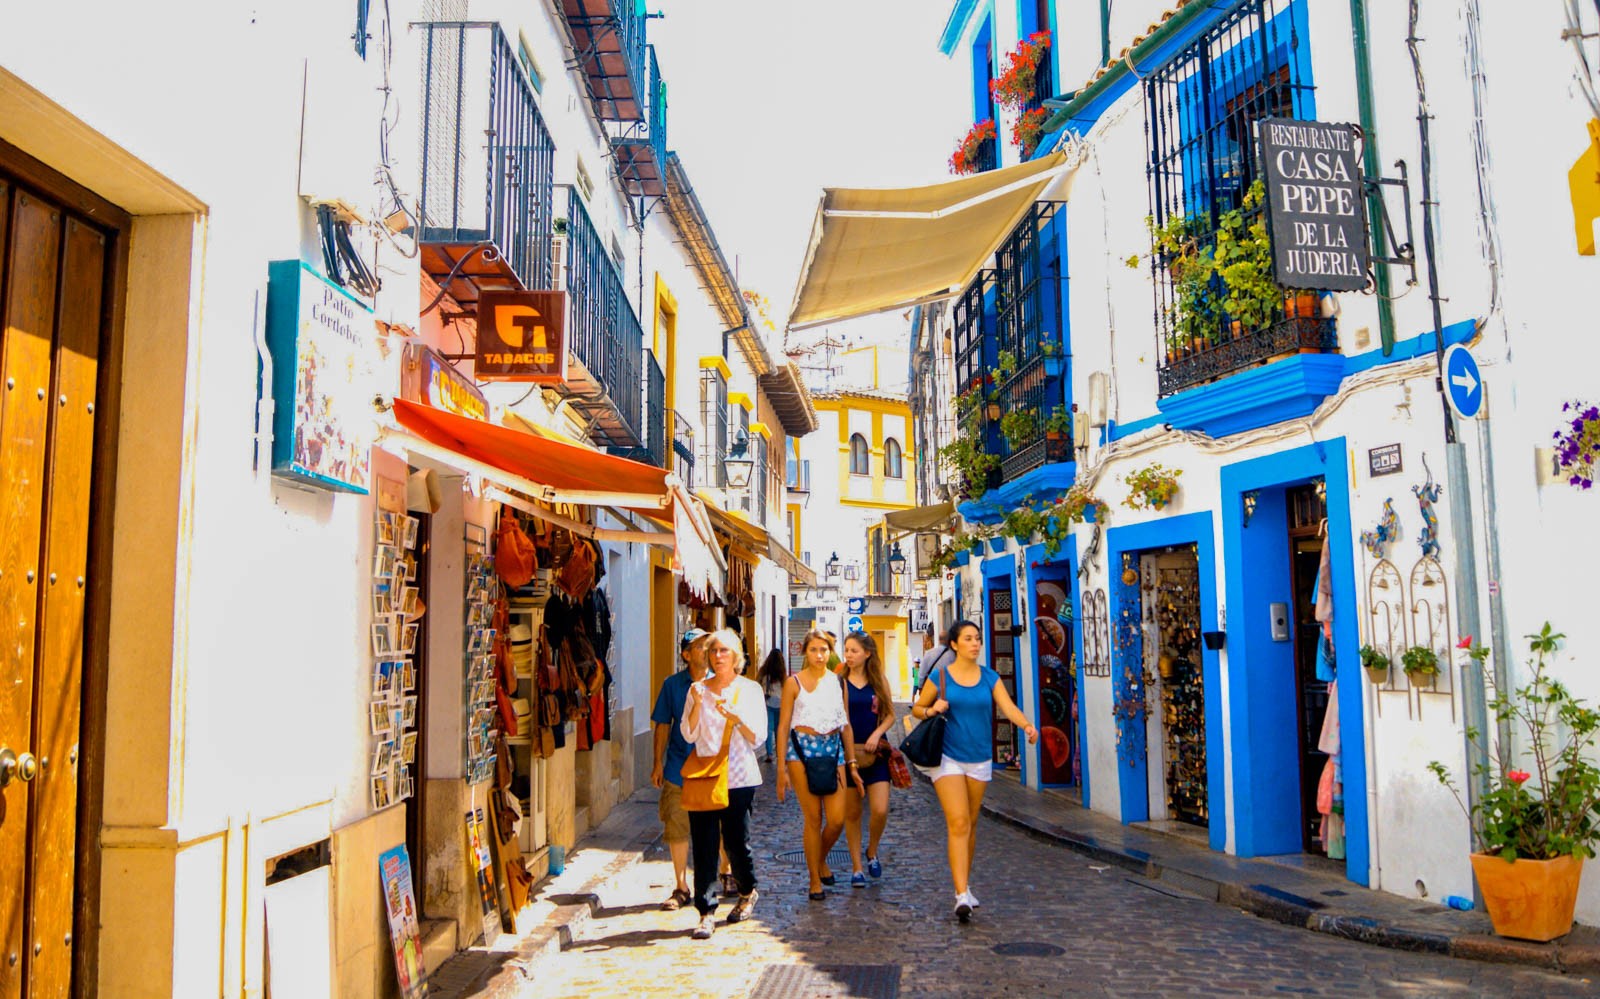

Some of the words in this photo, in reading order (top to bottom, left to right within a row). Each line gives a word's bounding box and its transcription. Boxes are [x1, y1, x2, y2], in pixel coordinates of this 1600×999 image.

[1270, 124, 1350, 151] RESTAURANTE
[1276, 149, 1352, 183] CASA
[1280, 183, 1355, 216] PEPE
[1294, 222, 1318, 247] DE
[1323, 223, 1348, 248] LA
[1286, 249, 1362, 277] JUDERIA
[323, 286, 354, 319] Patio
[484, 353, 555, 364] TABACOS
